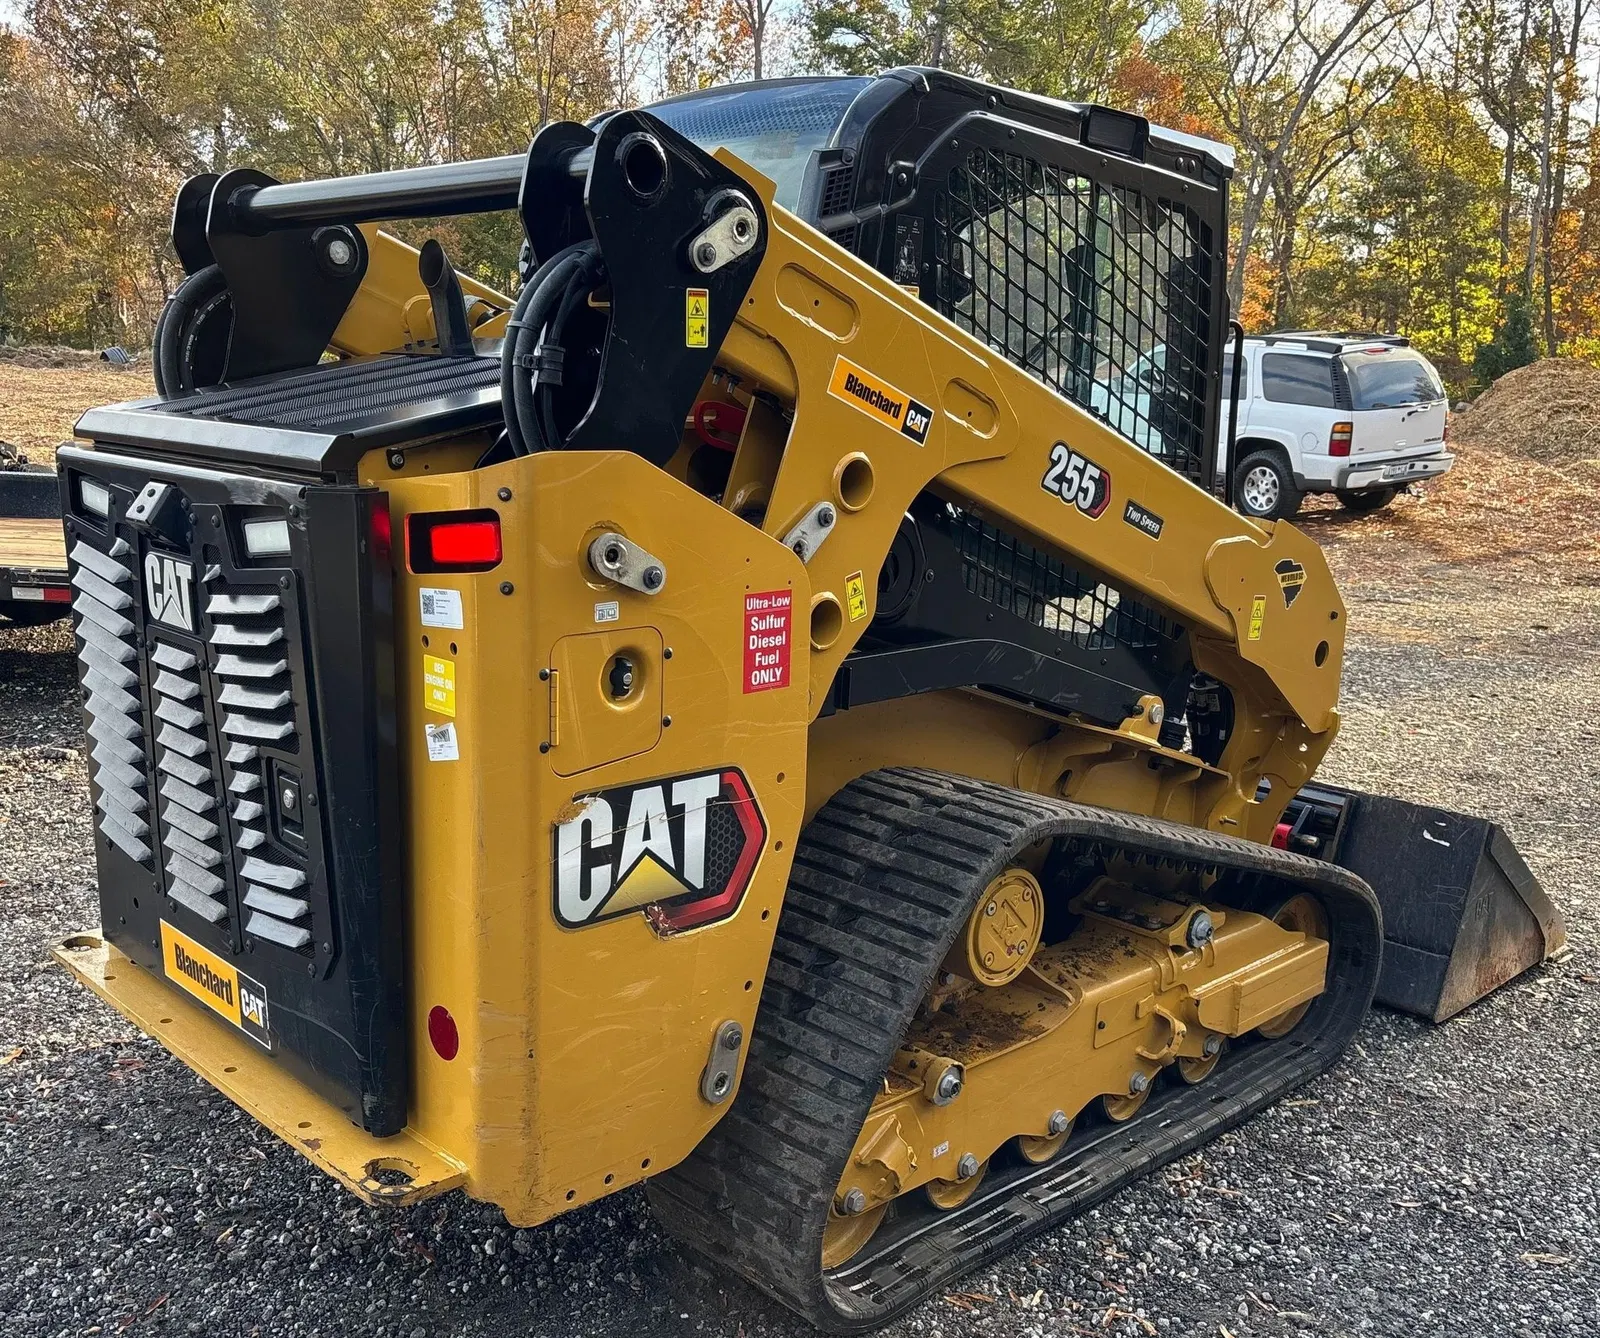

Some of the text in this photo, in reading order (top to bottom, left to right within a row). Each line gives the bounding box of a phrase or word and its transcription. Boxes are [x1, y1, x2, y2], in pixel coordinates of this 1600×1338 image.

[844, 372, 928, 434] Blanchard CAT
[1043, 445, 1101, 510] 255
[145, 553, 194, 631] CAT
[746, 595, 790, 611] Ultra-Low
[750, 614, 786, 632] Sulfur
[749, 631, 786, 650] Diesel
[755, 649, 780, 667] Fuel
[751, 667, 783, 685] ONLY
[432, 688, 447, 703] ONLY
[558, 773, 720, 923] CAT
[174, 942, 264, 1029] Blanchard CAT
